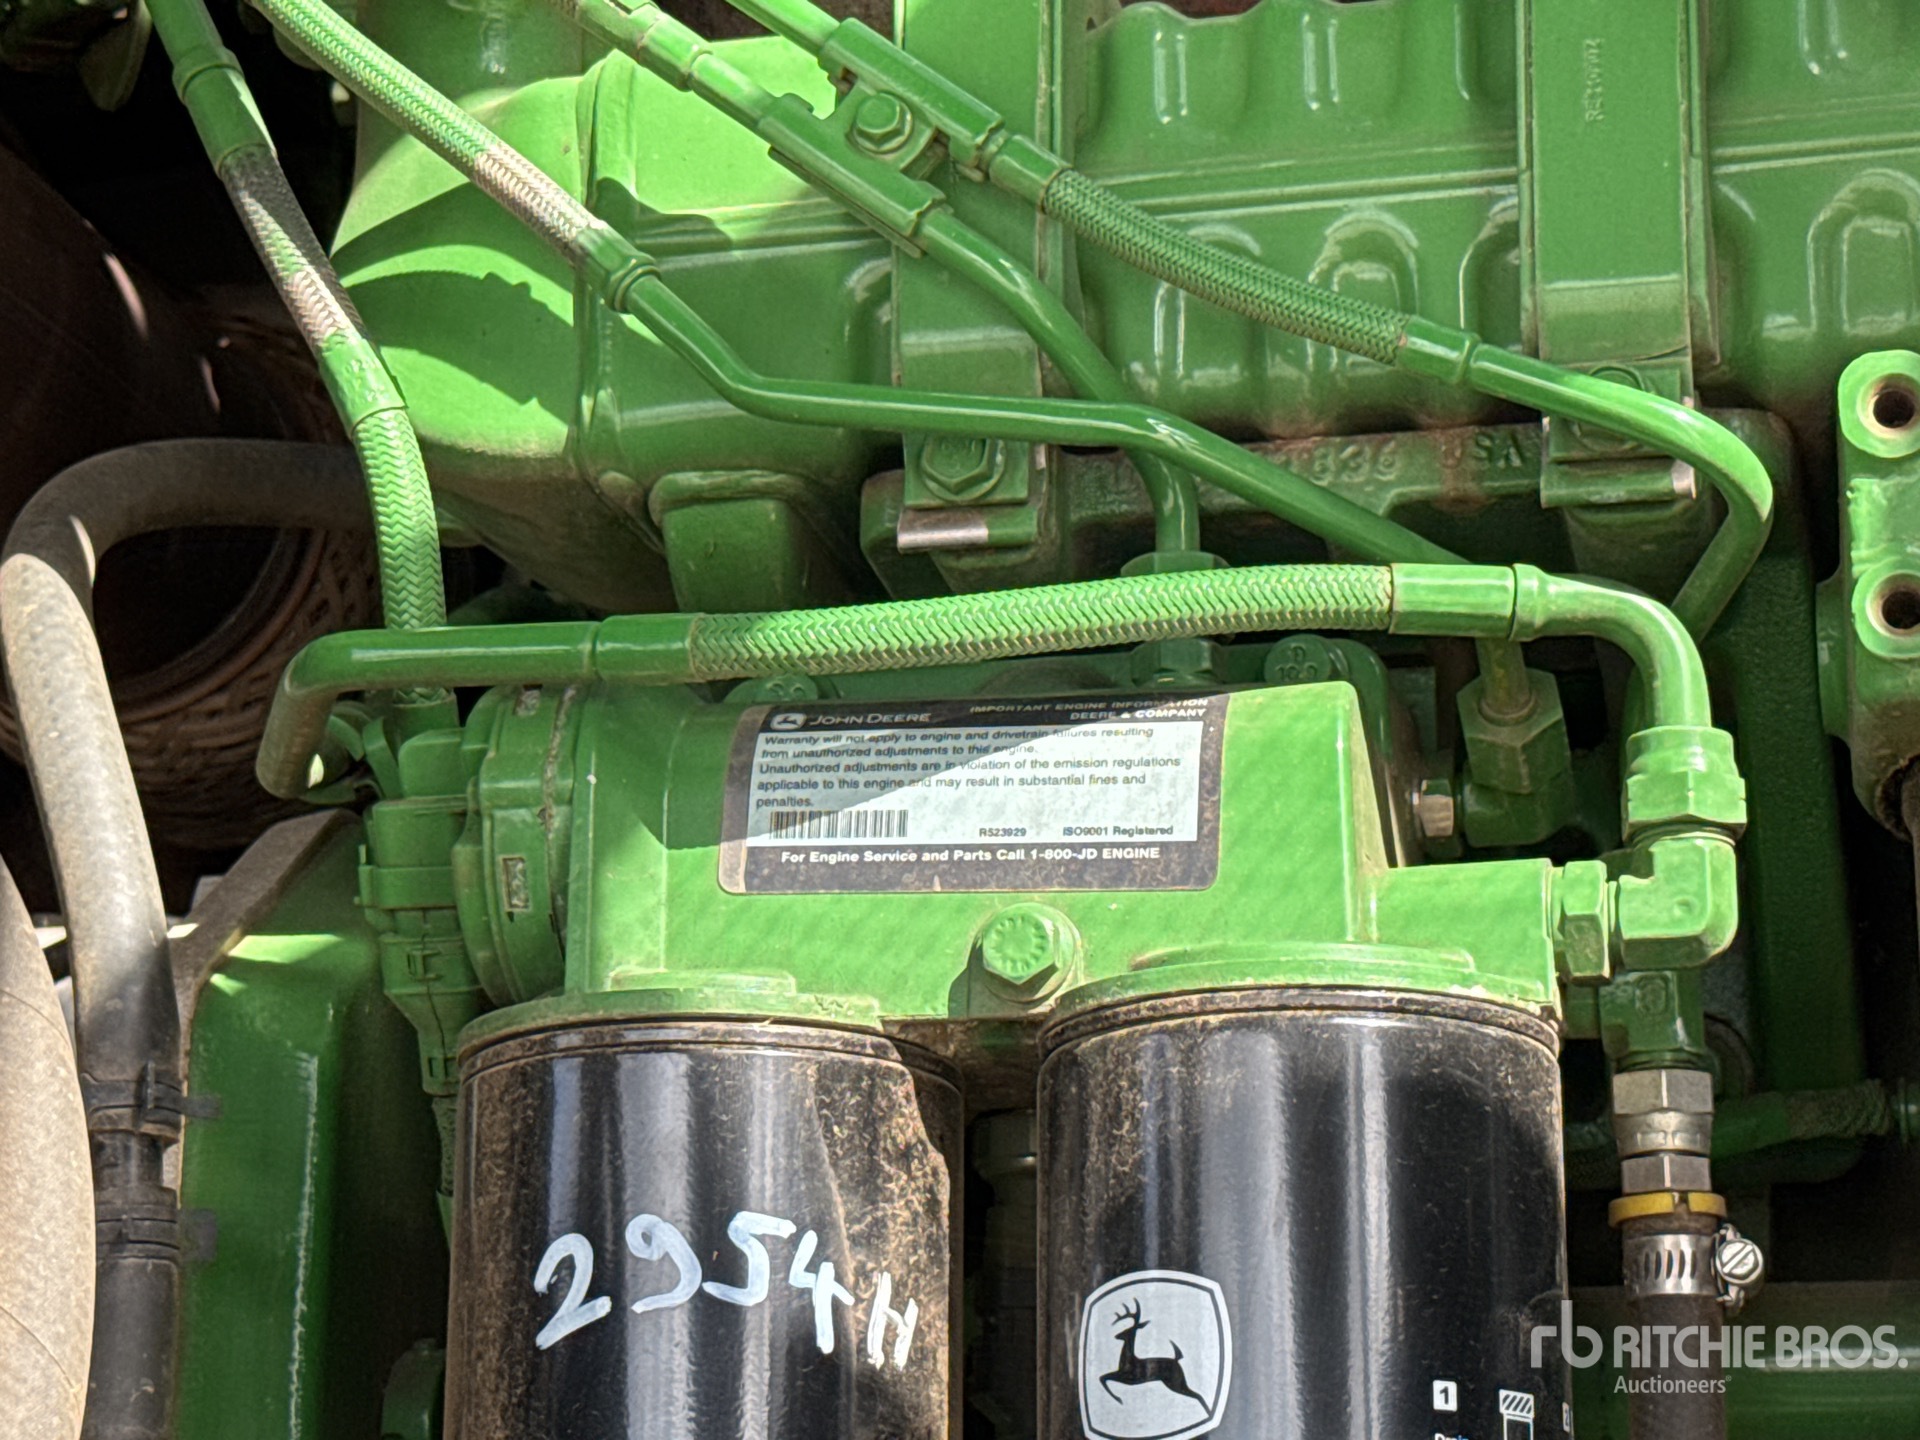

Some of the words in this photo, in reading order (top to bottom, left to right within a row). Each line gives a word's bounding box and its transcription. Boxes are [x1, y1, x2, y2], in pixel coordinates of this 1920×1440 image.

[969, 703, 1052, 713] IMPORTANT
[1055, 701, 1107, 711] ENGINE
[1111, 698, 1208, 709] INFORMATION
[809, 715, 864, 726] JOHN
[867, 713, 932, 723] DEERE
[1135, 708, 1207, 719] COMPANY
[765, 735, 820, 746] Warranty
[822, 734, 842, 745] will
[846, 734, 865, 743] not
[867, 733, 901, 744] apply
[905, 733, 917, 742] to
[920, 732, 962, 743] engine
[965, 731, 989, 740] and
[992, 729, 1048, 740] drivetrain
[1052, 728, 1097, 738] failures
[1101, 727, 1154, 738] resulting
[762, 749, 788, 759] from
[792, 747, 871, 758] unauthorized
[874, 745, 948, 757] adjustments
[952, 745, 964, 755] to
[968, 744, 991, 754] this
[760, 762, 840, 774] Unauthorized
[843, 761, 918, 774] adjustments
[921, 763, 941, 771] are
[945, 760, 956, 770] in
[959, 759, 1010, 770] violation
[1014, 759, 1027, 769] of
[1030, 758, 1049, 769] the
[1053, 756, 1108, 768] emission
[1112, 756, 1181, 770] regulations
[757, 779, 819, 791] applicable
[822, 779, 834, 789] to
[838, 779, 860, 789] this
[863, 778, 905, 791] engine
[907, 777, 931, 788] and
[935, 778, 961, 790] may
[965, 775, 999, 787] result
[1003, 775, 1014, 787] in
[1018, 773, 1085, 786] substantial
[1089, 774, 1118, 785] fines
[1122, 773, 1146, 784] and
[756, 796, 814, 809] penalties.
[978, 827, 1027, 838] R523929
[1062, 825, 1108, 837] ISO9001
[1112, 825, 1174, 837] Registered
[781, 851, 806, 863] For
[809, 850, 859, 865] Engine
[863, 850, 917, 863] Service
[921, 850, 949, 862] and
[953, 849, 992, 861] Parts
[996, 848, 1025, 861] Call
[1030, 847, 1098, 860] 1-800-JD
[1102, 847, 1161, 860] ENGINE
[1440, 1386, 1449, 1405] 1
